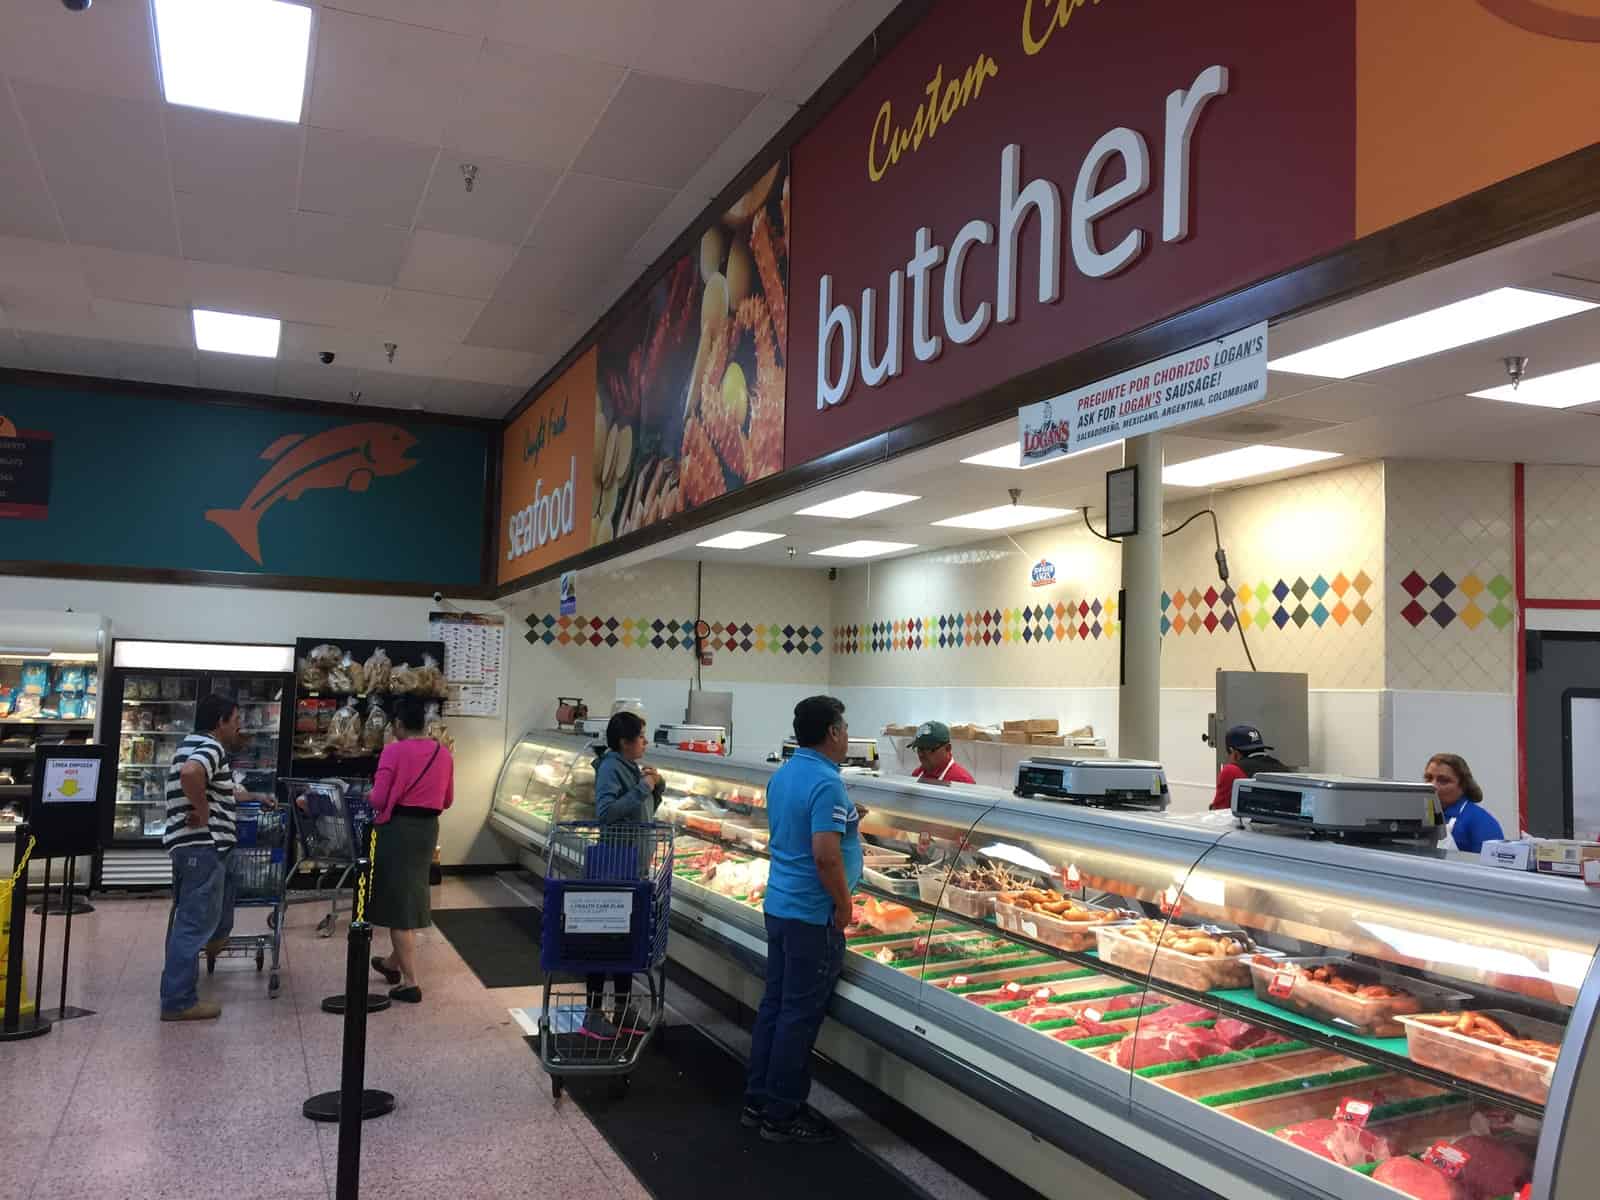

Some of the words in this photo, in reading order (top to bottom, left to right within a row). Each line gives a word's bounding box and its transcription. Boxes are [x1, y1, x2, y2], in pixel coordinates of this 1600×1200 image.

[869, 54, 998, 182] Custom
[817, 64, 1228, 409] butcher
[1077, 383, 1126, 411] PREGUNTE
[1129, 375, 1150, 394] POR
[1153, 355, 1210, 386] CHORIZOS
[1214, 336, 1264, 367] LOGAN'S
[1077, 412, 1095, 429] ASK
[1097, 404, 1116, 423] FOR
[1119, 390, 1162, 416] LOGAN'S
[1165, 371, 1222, 401] SAUSAGE!
[1162, 397, 1205, 417] ARGENTINA,
[1208, 379, 1259, 404] COLOMBIANO
[507, 455, 577, 561] seafood
